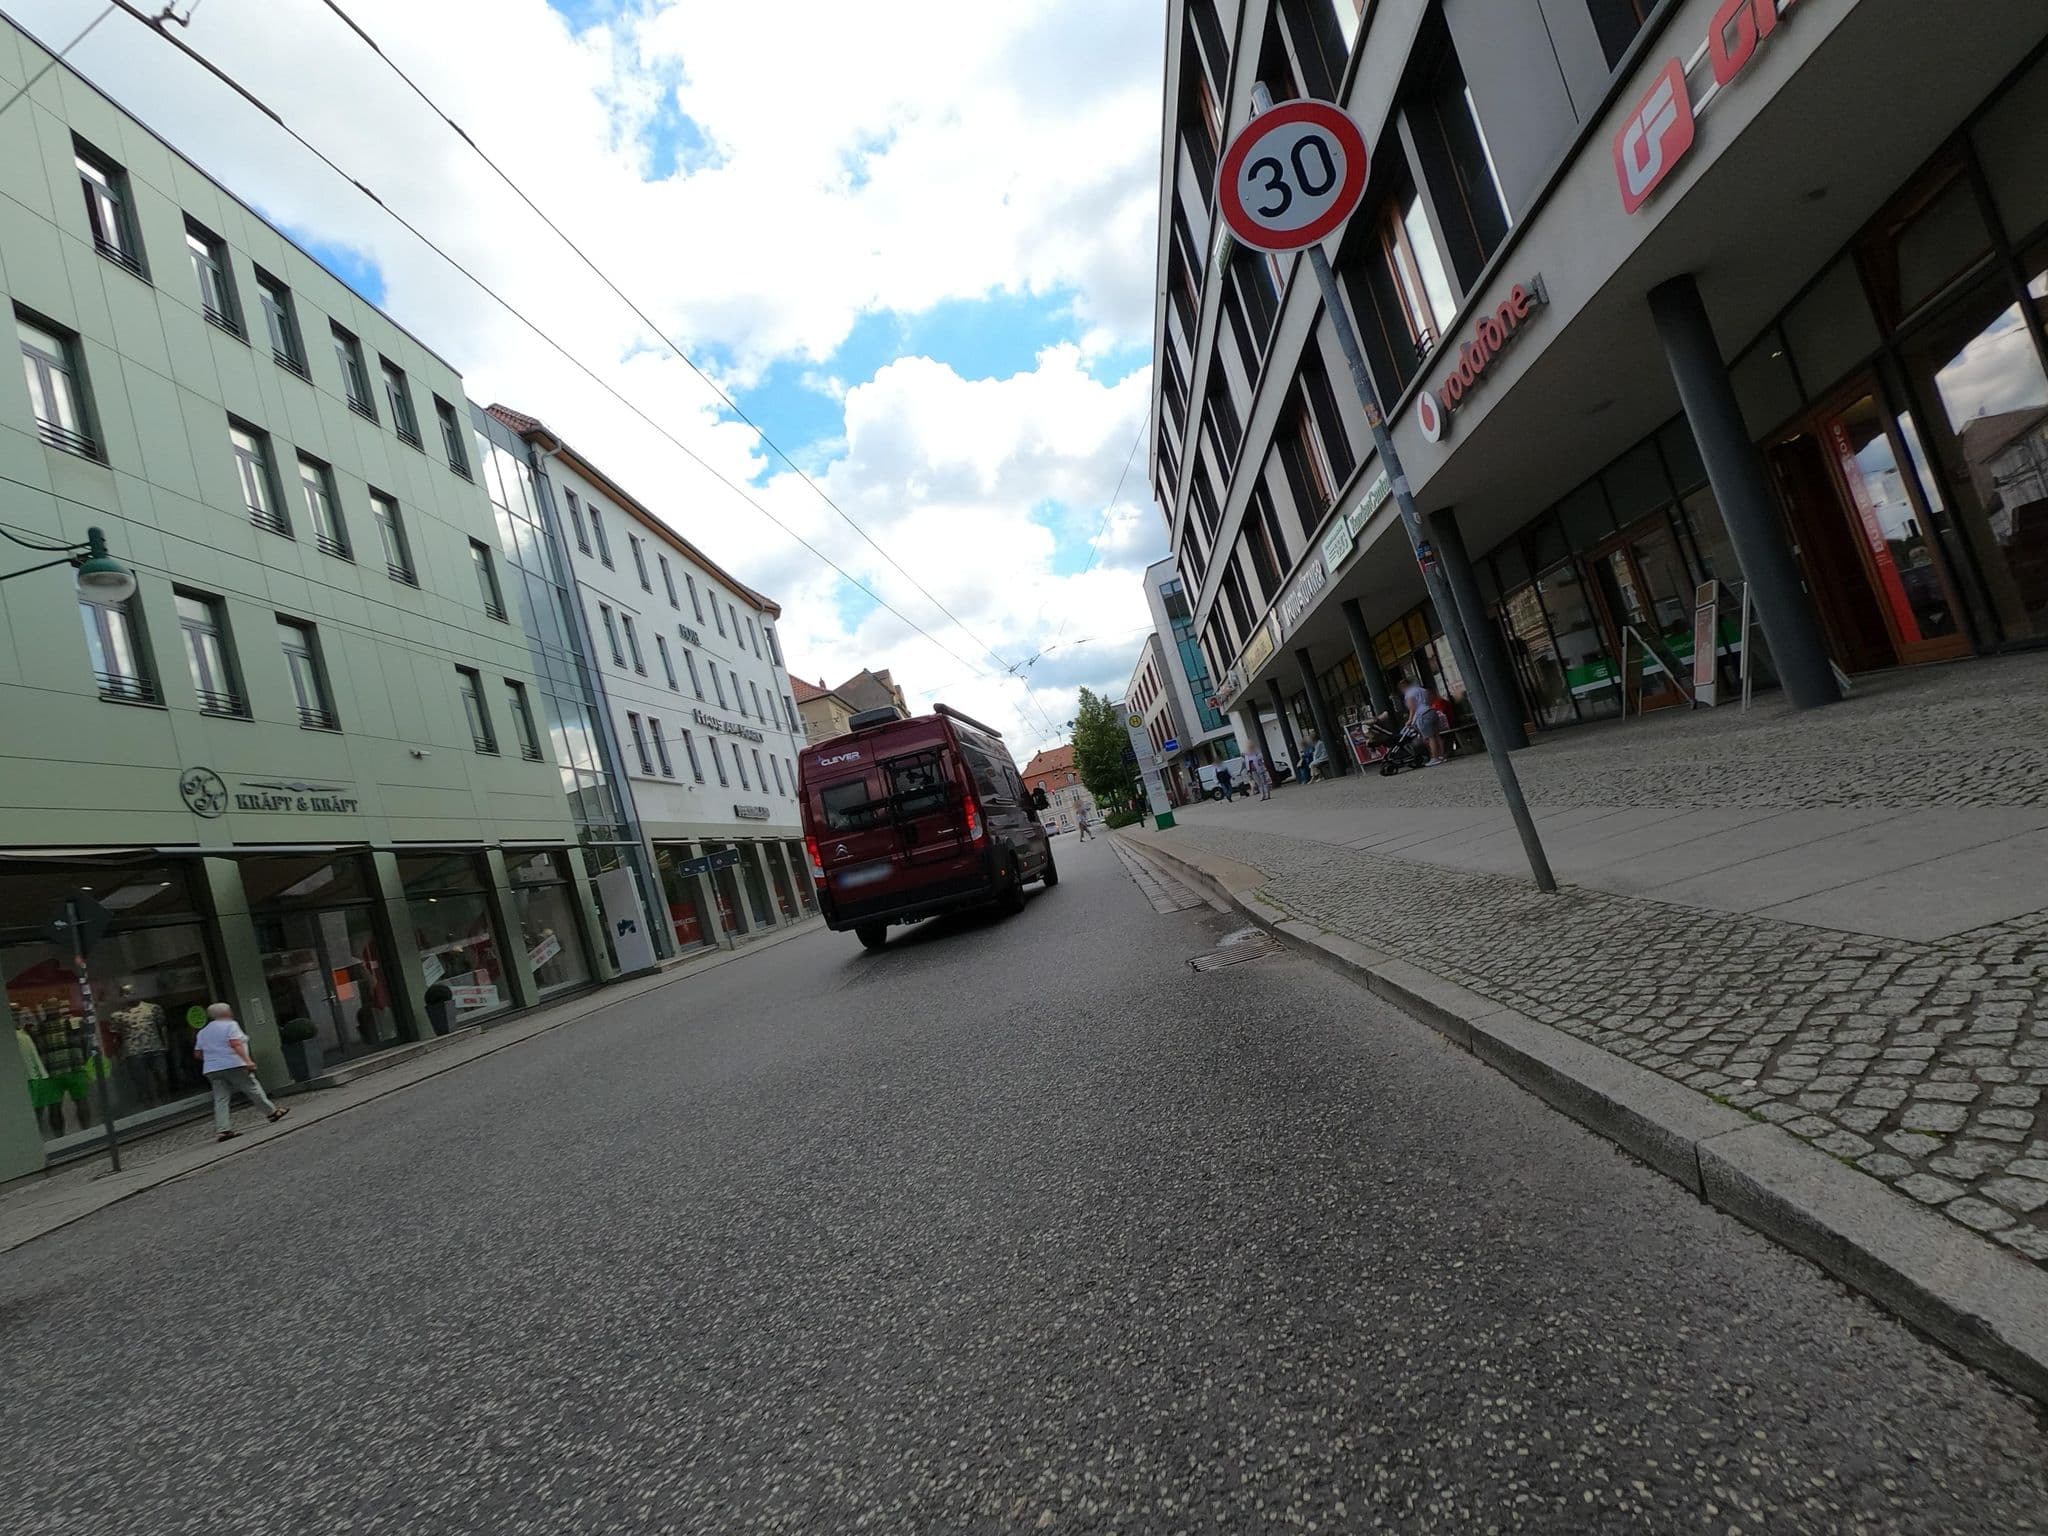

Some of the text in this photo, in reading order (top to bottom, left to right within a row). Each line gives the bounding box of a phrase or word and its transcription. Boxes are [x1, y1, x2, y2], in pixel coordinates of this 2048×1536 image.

[1247, 134, 1337, 218] 30
[1438, 283, 1530, 411] vodafone
[821, 751, 861, 766] CLEVER
